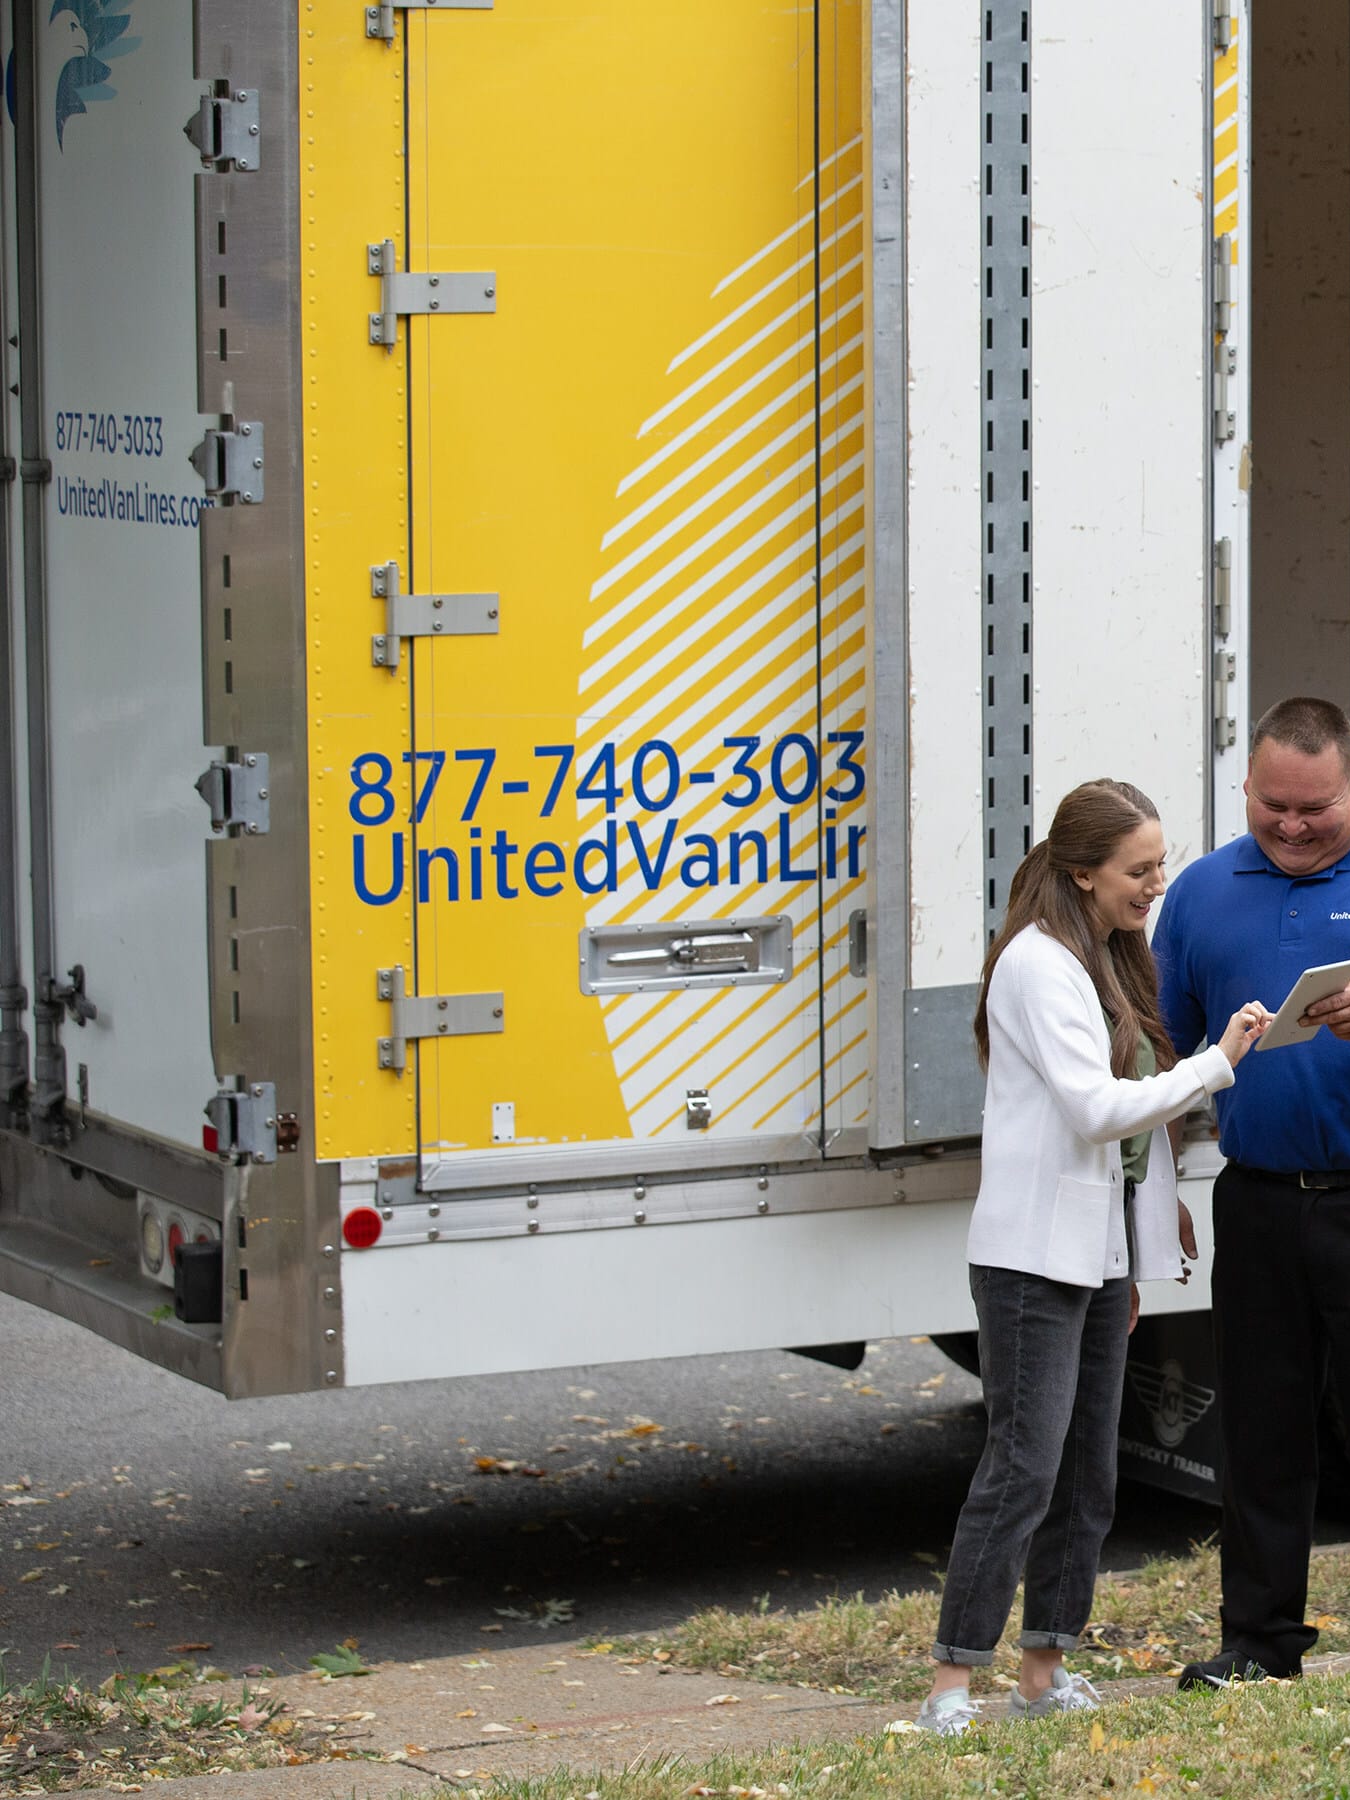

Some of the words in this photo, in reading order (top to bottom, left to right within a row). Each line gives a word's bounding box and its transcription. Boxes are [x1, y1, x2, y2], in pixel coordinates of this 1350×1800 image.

[56, 411, 164, 457] 877-740-3033
[348, 731, 865, 826] 877-740-303
[1173, 1454, 1216, 1482] TRAILER
